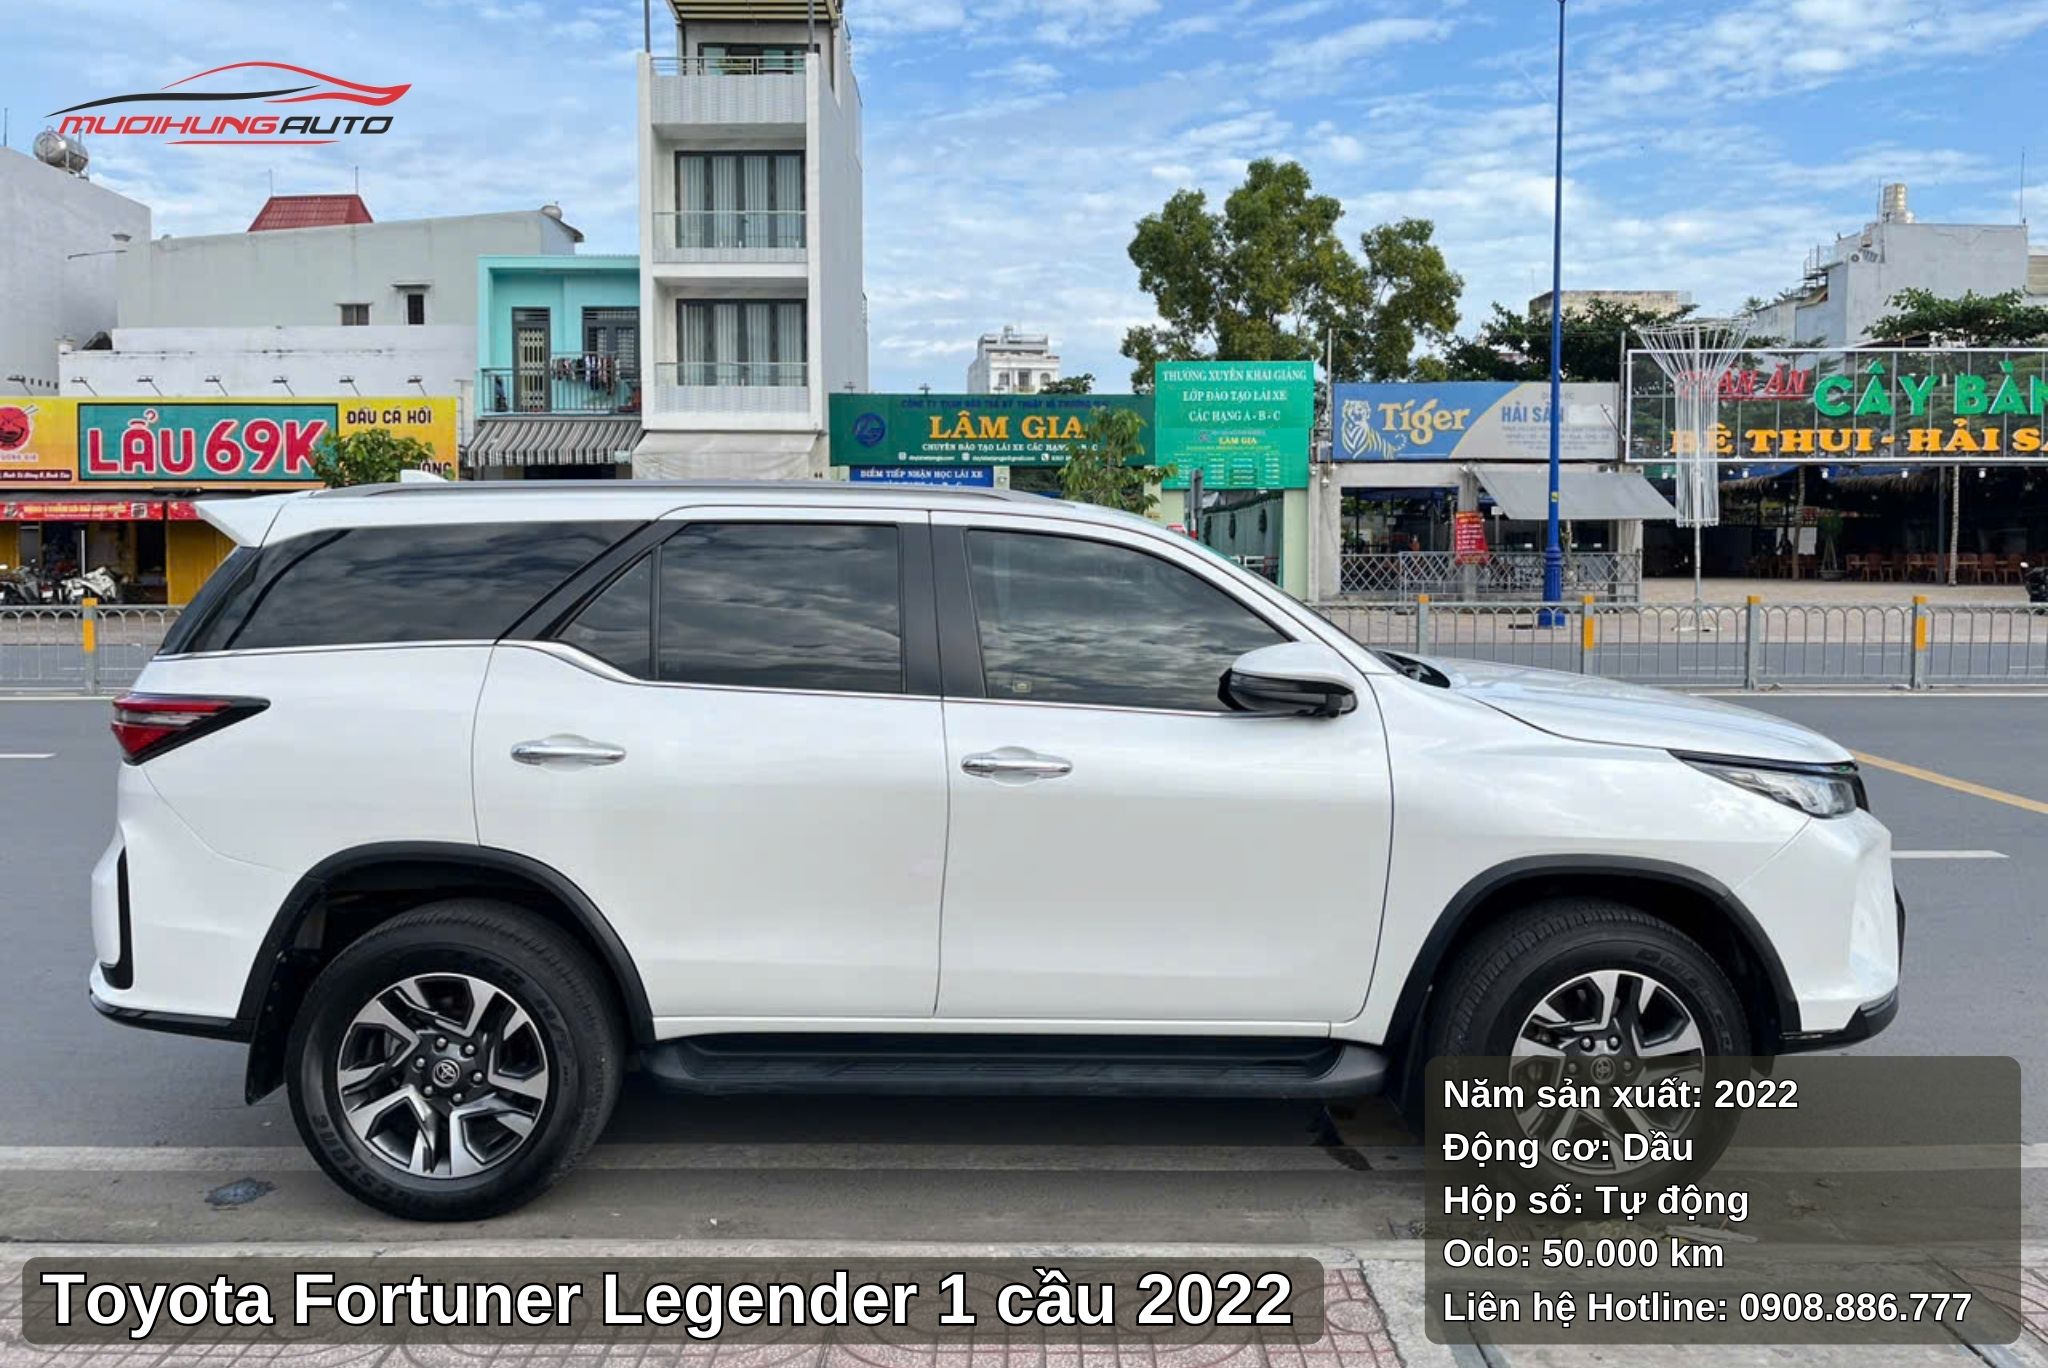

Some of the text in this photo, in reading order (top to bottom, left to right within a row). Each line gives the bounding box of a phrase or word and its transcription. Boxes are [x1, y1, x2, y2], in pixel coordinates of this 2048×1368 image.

[1208, 368, 1244, 382] XUYÊN
[1245, 369, 1272, 382] KHAI
[1764, 362, 1811, 393] ĂN
[1254, 388, 1272, 402] LÁI
[1272, 390, 1287, 401] XE
[1813, 358, 1940, 417] CÂY
[382, 404, 402, 424] CÁ
[1188, 408, 1211, 422] CÁC
[1243, 411, 1251, 421] A
[1259, 410, 1266, 421] B
[1273, 410, 1281, 421] C
[1378, 399, 1471, 445] Tiger
[1501, 401, 1564, 423] HẢI SẢ
[929, 410, 1087, 439] LÂM GIA
[87, 409, 328, 475] LẨU 69K
[922, 442, 956, 451] CHUYÊN
[996, 442, 1011, 451] LÁI
[1012, 443, 1024, 451] XE
[1744, 427, 1874, 454] THUI
[1906, 418, 2001, 453] HẢI
[2012, 427, 2048, 453] S
[954, 467, 969, 478] LÁI
[970, 470, 983, 478] XE
